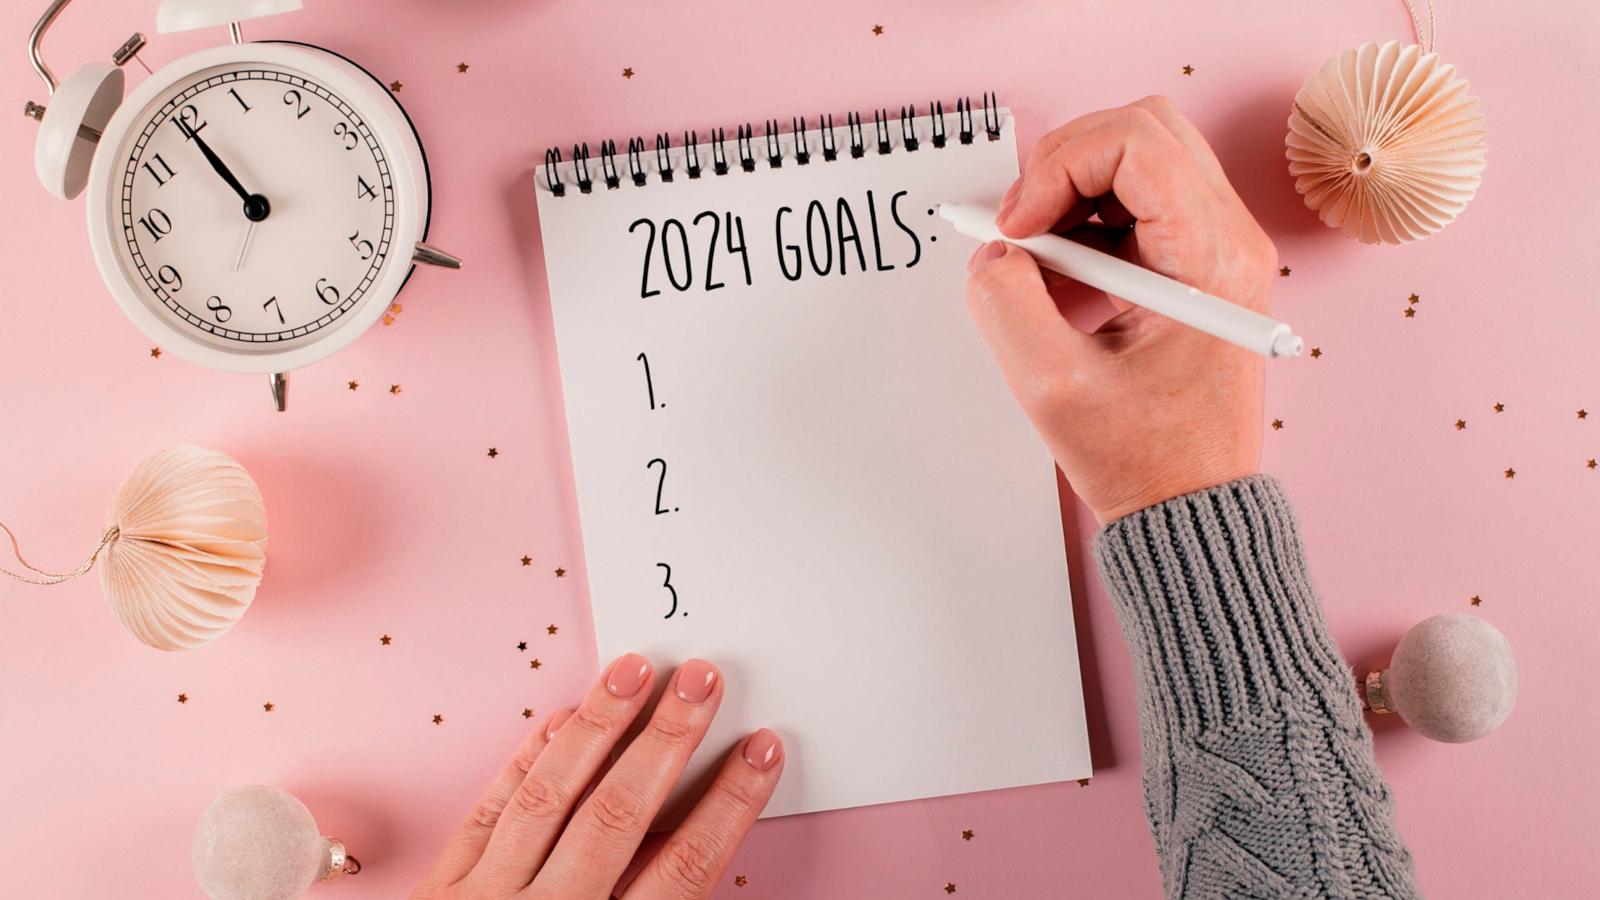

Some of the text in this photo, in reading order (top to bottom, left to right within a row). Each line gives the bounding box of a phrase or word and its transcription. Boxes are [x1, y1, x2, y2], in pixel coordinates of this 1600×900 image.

[227, 88, 253, 114] 1
[284, 90, 311, 119] 2
[169, 105, 207, 142] 12
[334, 121, 358, 151] 3
[142, 153, 178, 188] 11
[356, 174, 380, 202] 4
[138, 208, 172, 243] 10
[348, 230, 374, 260] 5
[629, 189, 938, 299] 2024 GOALS:
[158, 265, 183, 292] 9
[315, 278, 340, 305] 6
[206, 296, 232, 323] 8
[263, 296, 286, 324] 7
[636, 352, 666, 410] 1.
[646, 458, 680, 515] 2.
[656, 562, 688, 619] 3.
